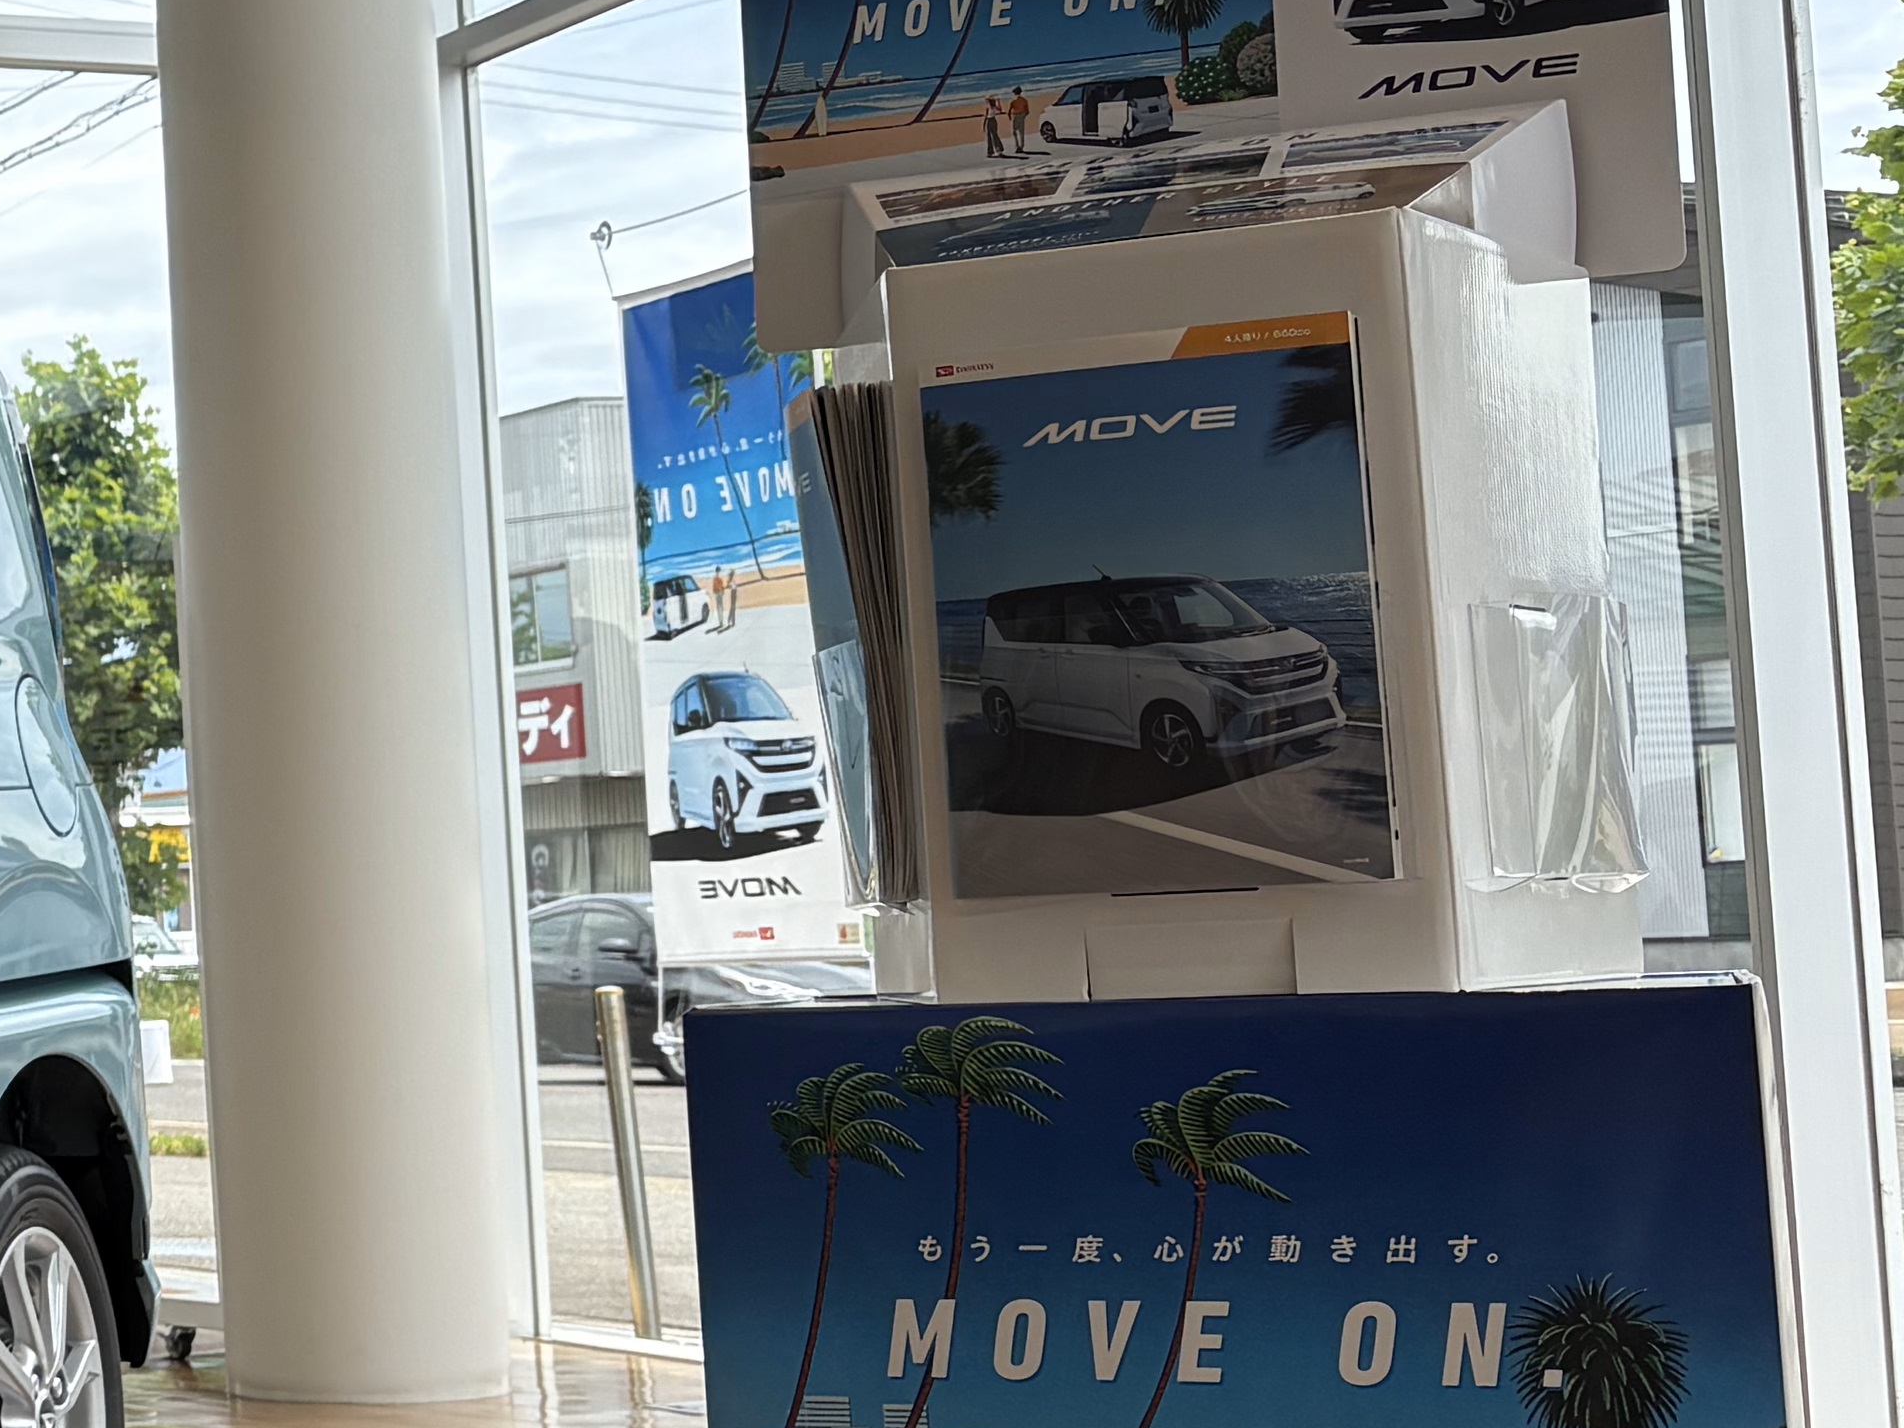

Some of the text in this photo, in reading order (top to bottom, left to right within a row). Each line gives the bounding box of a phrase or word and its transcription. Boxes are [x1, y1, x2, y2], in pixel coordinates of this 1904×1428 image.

[1358, 53, 1580, 99] MOVE
[991, 190, 1177, 222] ANOTHER
[1201, 173, 1334, 196] STYLE
[1022, 404, 1238, 448] MOVE
[917, 1233, 1503, 1269] もう一度、心が動き出す。
[886, 1297, 1565, 1390] MOVE ON.
